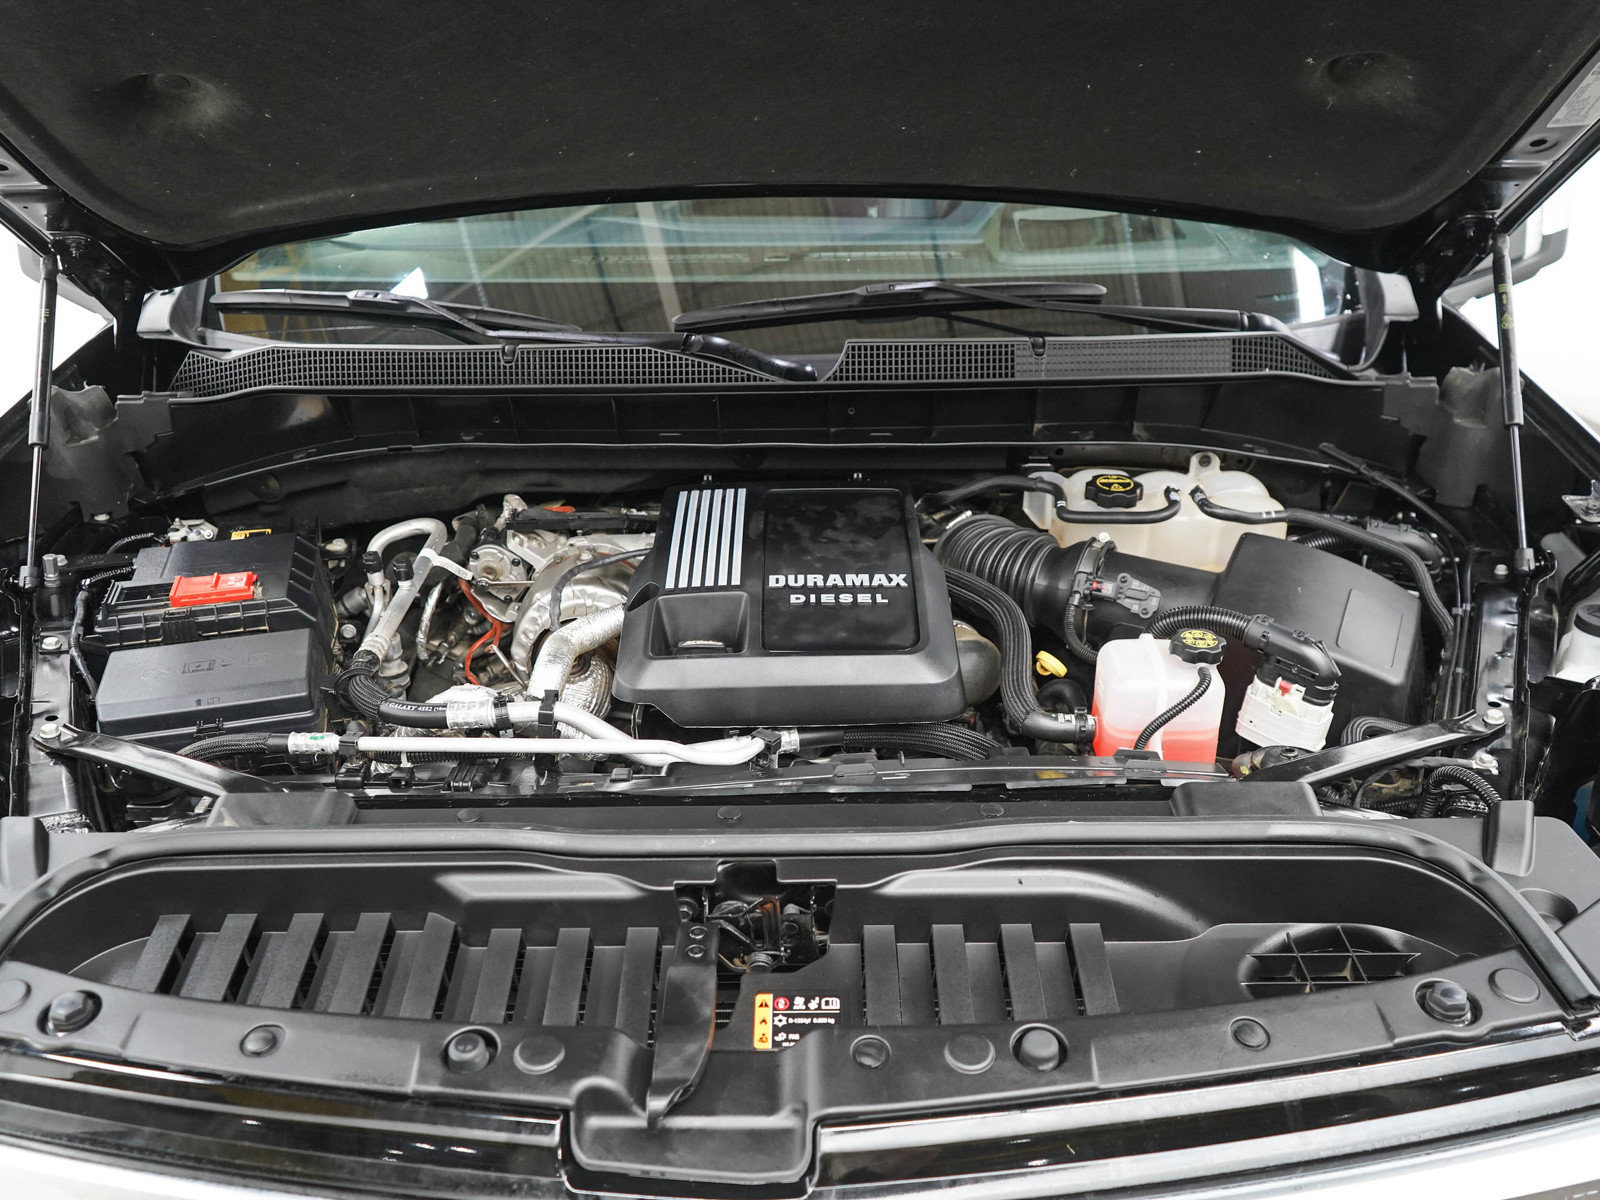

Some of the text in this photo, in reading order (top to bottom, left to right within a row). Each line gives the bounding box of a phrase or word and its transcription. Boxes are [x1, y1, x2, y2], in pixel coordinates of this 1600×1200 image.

[768, 573, 909, 588] DURAMAX
[789, 593, 889, 604] DIESEL
[389, 702, 417, 711] GALAXY
